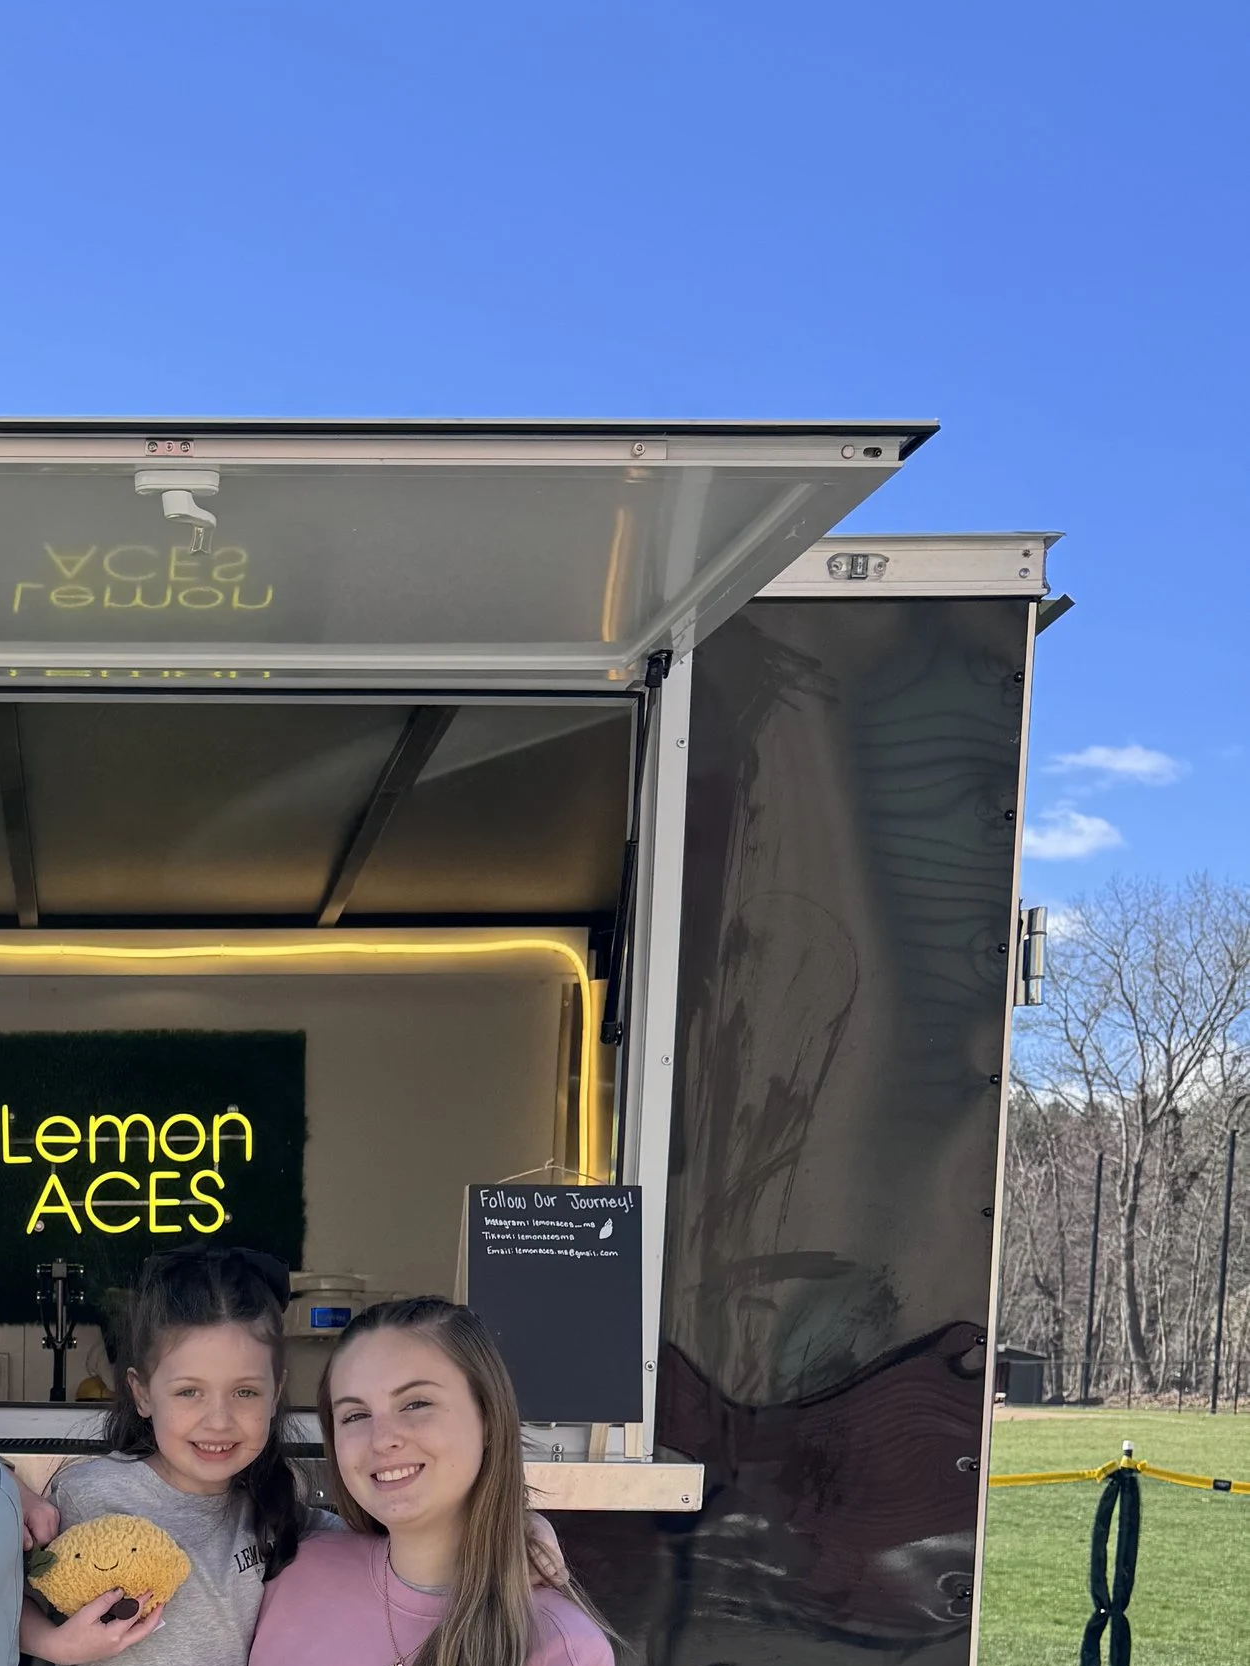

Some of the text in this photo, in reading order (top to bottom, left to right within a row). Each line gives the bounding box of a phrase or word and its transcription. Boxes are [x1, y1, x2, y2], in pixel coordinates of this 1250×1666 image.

[1, 1103, 253, 1165] Lemon
[26, 1169, 226, 1235] ACES
[479, 1189, 635, 1214] Follow Our Journey!
